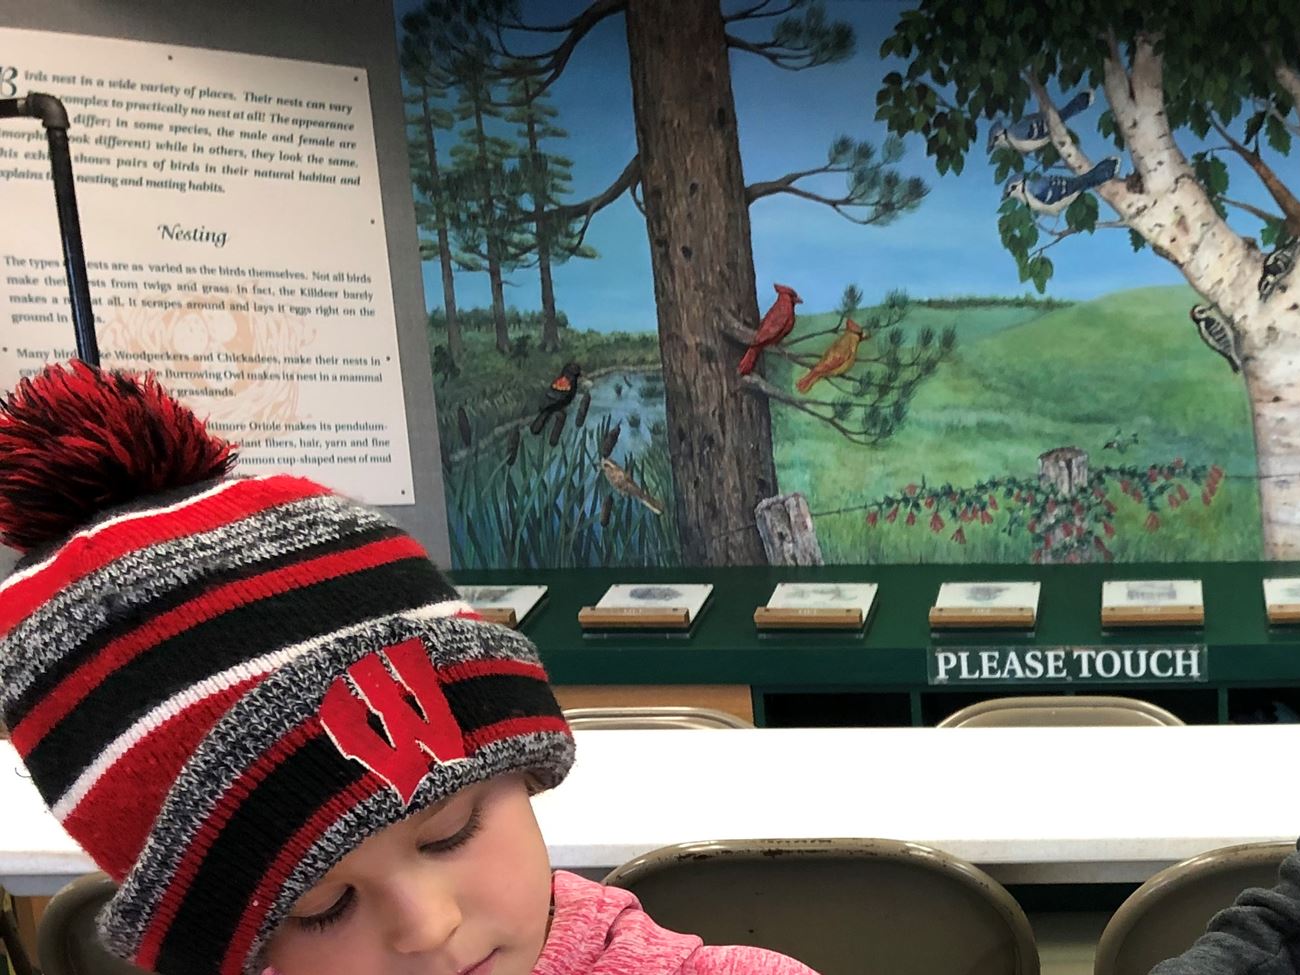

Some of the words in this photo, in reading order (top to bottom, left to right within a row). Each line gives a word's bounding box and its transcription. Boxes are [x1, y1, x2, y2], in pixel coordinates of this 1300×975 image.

[52, 75, 76, 84] nest
[81, 75, 93, 86] in
[97, 79, 104, 87] a
[109, 79, 136, 90] wide
[140, 82, 181, 95] variety
[184, 86, 195, 98] of
[199, 87, 236, 100] places.
[244, 91, 272, 103] Their
[276, 95, 303, 108] nests
[306, 98, 325, 109] can
[329, 101, 353, 115] vary
[111, 97, 124, 108] to
[126, 98, 188, 116] practically
[191, 106, 206, 116] no
[208, 107, 231, 118] nest
[233, 109, 244, 120] at
[270, 113, 290, 124] The
[291, 117, 355, 131] appearance
[116, 117, 128, 128] in
[134, 121, 164, 131] some
[169, 122, 212, 137] species,
[216, 126, 235, 138] the
[240, 129, 267, 140] male
[272, 133, 294, 143] and
[298, 134, 335, 147] female
[339, 140, 357, 150] are
[69, 134, 90, 145] ook
[156, 141, 188, 152] while
[193, 143, 204, 154] in
[209, 145, 247, 158] others,
[251, 149, 275, 162] they
[279, 150, 302, 162] look
[307, 153, 324, 165] the
[328, 157, 358, 168] same.
[0, 147, 17, 158] his
[74, 152, 111, 165] shows
[117, 157, 148, 169] pairs
[153, 159, 166, 172] of
[170, 160, 199, 173] birds
[205, 162, 216, 173] in
[222, 164, 249, 176] their
[254, 168, 294, 181] natural
[299, 171, 336, 184] habitat
[340, 175, 361, 186] and
[0, 167, 43, 182] xplains
[76, 173, 118, 187] nesting
[120, 176, 143, 187] and
[146, 179, 186, 193] mating
[188, 180, 225, 193] habits.
[157, 223, 227, 248] Nesting
[4, 255, 26, 267] The
[29, 257, 59, 271] types
[87, 261, 108, 270] ests
[111, 261, 129, 271] are
[132, 263, 144, 272] as
[148, 262, 183, 273] varied
[185, 265, 197, 274] as
[199, 265, 217, 275] the
[218, 266, 246, 277] birds
[248, 268, 308, 280] themselves.
[312, 270, 330, 282] Not
[332, 272, 345, 283] all
[347, 272, 372, 284] birds
[6, 275, 39, 286] make
[44, 275, 66, 287] thei
[111, 278, 138, 289] from
[143, 280, 172, 293] twigs
[177, 281, 197, 291] and
[202, 283, 232, 295] grass.
[236, 284, 248, 294] In
[252, 285, 275, 296] fact,
[279, 285, 296, 296] the
[300, 286, 338, 299] Killdeer
[343, 289, 373, 303] barely
[9, 293, 47, 304] makes
[51, 296, 58, 305] a
[128, 297, 137, 307] It
[141, 299, 183, 310] scrapes
[186, 301, 225, 311] around
[229, 302, 250, 312] and
[254, 302, 274, 315] lays
[278, 303, 285, 314] it
[289, 305, 312, 317] eggs
[316, 304, 339, 317] right
[343, 307, 356, 317] on
[359, 306, 376, 317] the
[11, 312, 54, 324] ground
[56, 313, 68, 324] in
[16, 348, 50, 361] Many
[53, 348, 78, 360] bird
[114, 350, 192, 362] Woodpeckers
[193, 352, 214, 363] and
[217, 353, 281, 365] Chickadees,
[284, 354, 312, 365] make
[315, 355, 338, 366] their
[342, 356, 367, 367] nests
[370, 357, 381, 367] in
[165, 368, 222, 380] Burrowing
[224, 370, 245, 380] Owl
[247, 371, 280, 381] makes
[283, 371, 294, 381] its
[297, 372, 317, 382] nest
[319, 372, 330, 382] in
[332, 374, 338, 382] a
[339, 372, 383, 383] mammal
[176, 387, 236, 398] grasslands.
[207, 421, 246, 431] ltimore
[249, 421, 281, 432] Oriole
[284, 421, 317, 431] makes
[320, 421, 332, 431] its
[265, 438, 296, 449] fibers,
[300, 438, 322, 449] hair,
[325, 440, 347, 450] yarn
[350, 438, 368, 448] and
[372, 438, 390, 448] fine
[235, 456, 275, 465] ommon
[337, 454, 356, 464] nest
[359, 454, 369, 464] of
[370, 454, 392, 464] mud
[935, 650, 1067, 680] PLEASE
[1073, 649, 1201, 678] TOUCH
[319, 637, 467, 806] W
